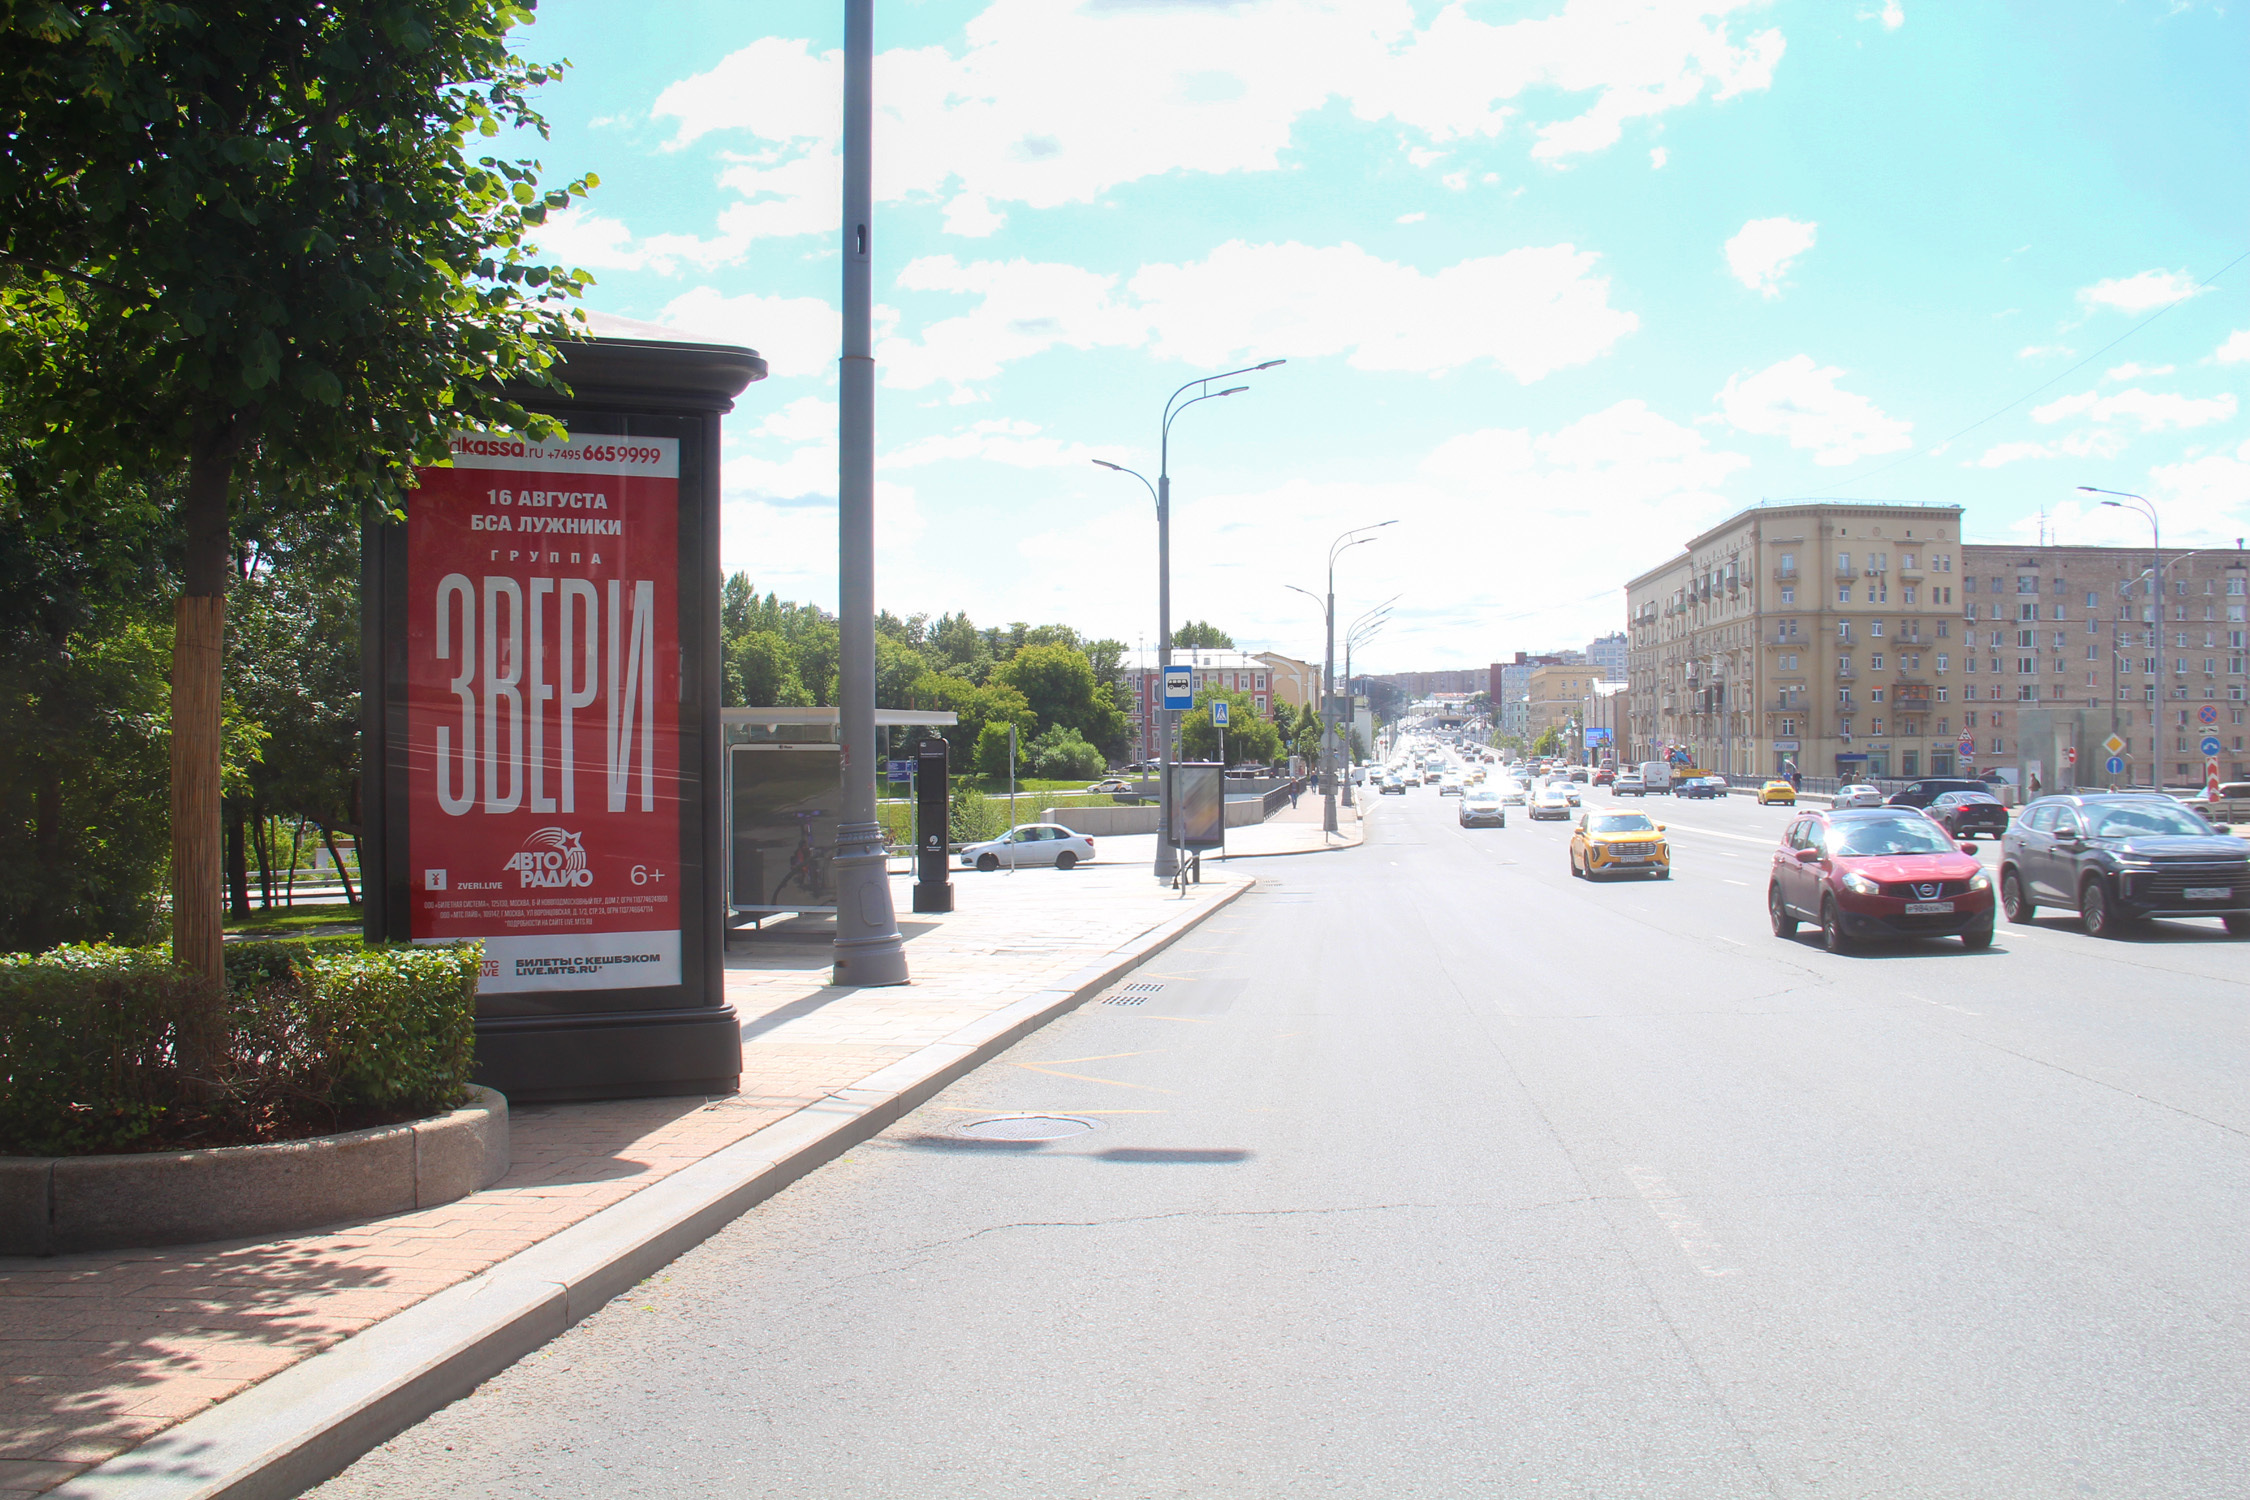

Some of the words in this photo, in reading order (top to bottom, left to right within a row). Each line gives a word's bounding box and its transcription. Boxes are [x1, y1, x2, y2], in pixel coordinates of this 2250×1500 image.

[547, 449, 581, 461] +7495
[583, 445, 661, 465] 6659999
[486, 489, 512, 506] 16
[518, 490, 608, 510] АВГУСТА
[471, 514, 512, 532] БСА
[517, 516, 621, 535] ЛУЖНИКИ
[490, 550, 602, 564] ГРУППА
[436, 573, 654, 816] ЗВЕРИ
[502, 851, 562, 871] АВТО
[520, 869, 593, 888] РАДИО
[630, 864, 665, 885] 6+
[457, 881, 503, 890] ZVERI.LIVE
[480, 960, 500, 969] ТС
[515, 957, 571, 968] БИЛЕТЫ
[571, 957, 583, 966] С
[585, 954, 661, 965] КЕШБЭКОМ
[480, 968, 499, 977] IVE
